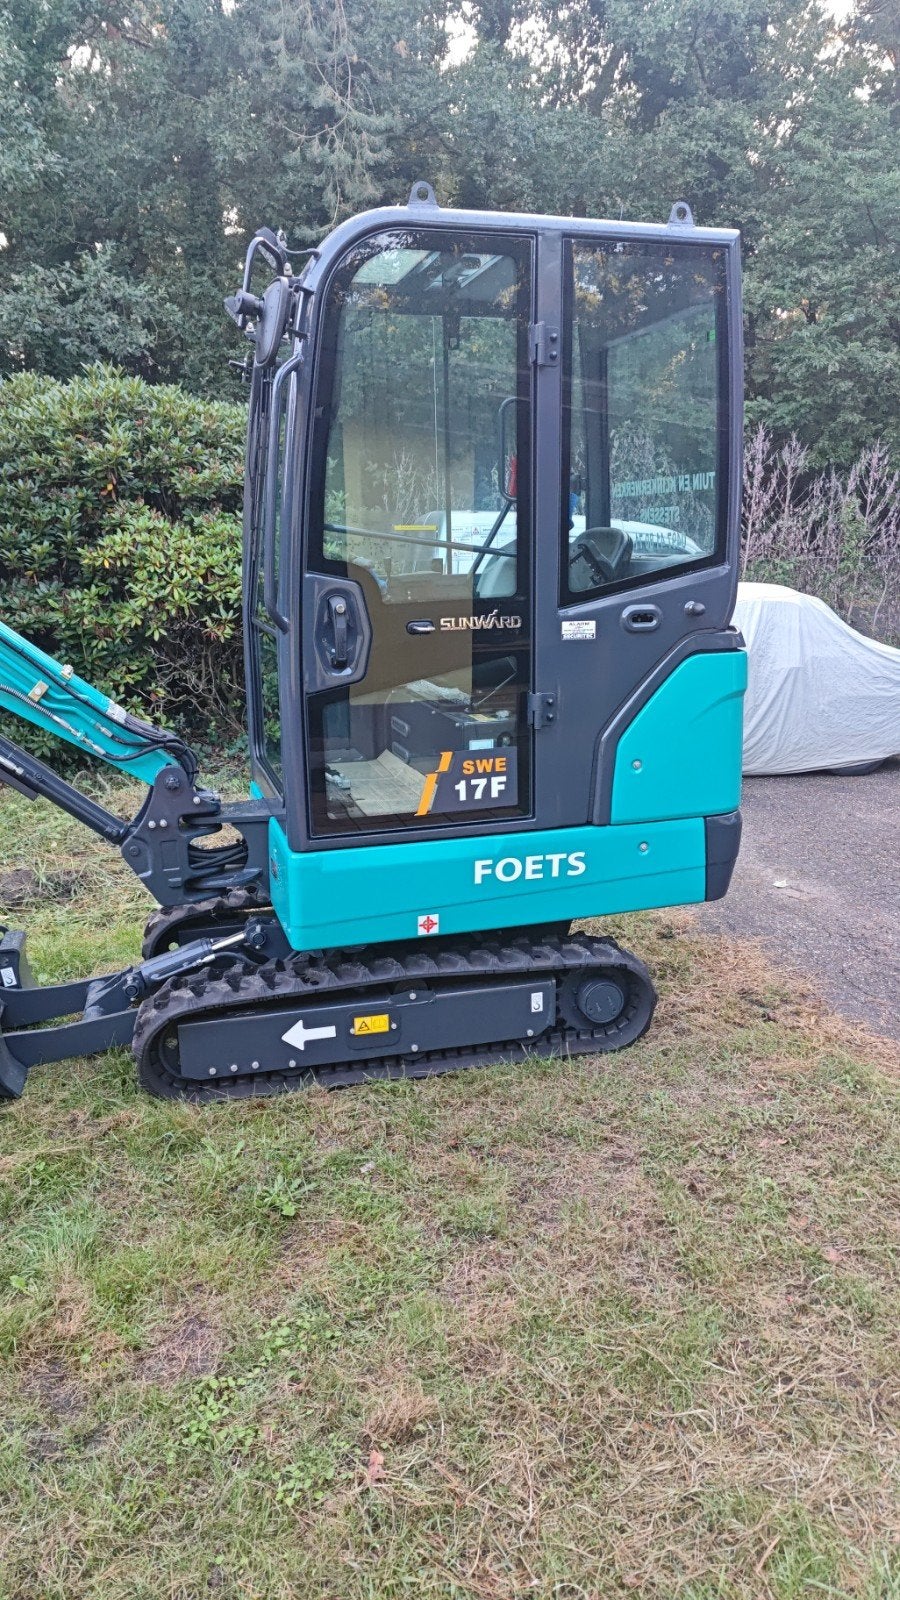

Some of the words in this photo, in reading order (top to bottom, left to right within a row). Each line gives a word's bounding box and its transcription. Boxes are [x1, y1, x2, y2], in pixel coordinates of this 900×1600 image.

[440, 609, 522, 630] SUNWARD
[462, 757, 507, 775] SWE
[454, 776, 507, 801] 17F
[474, 851, 586, 885] FOETS
